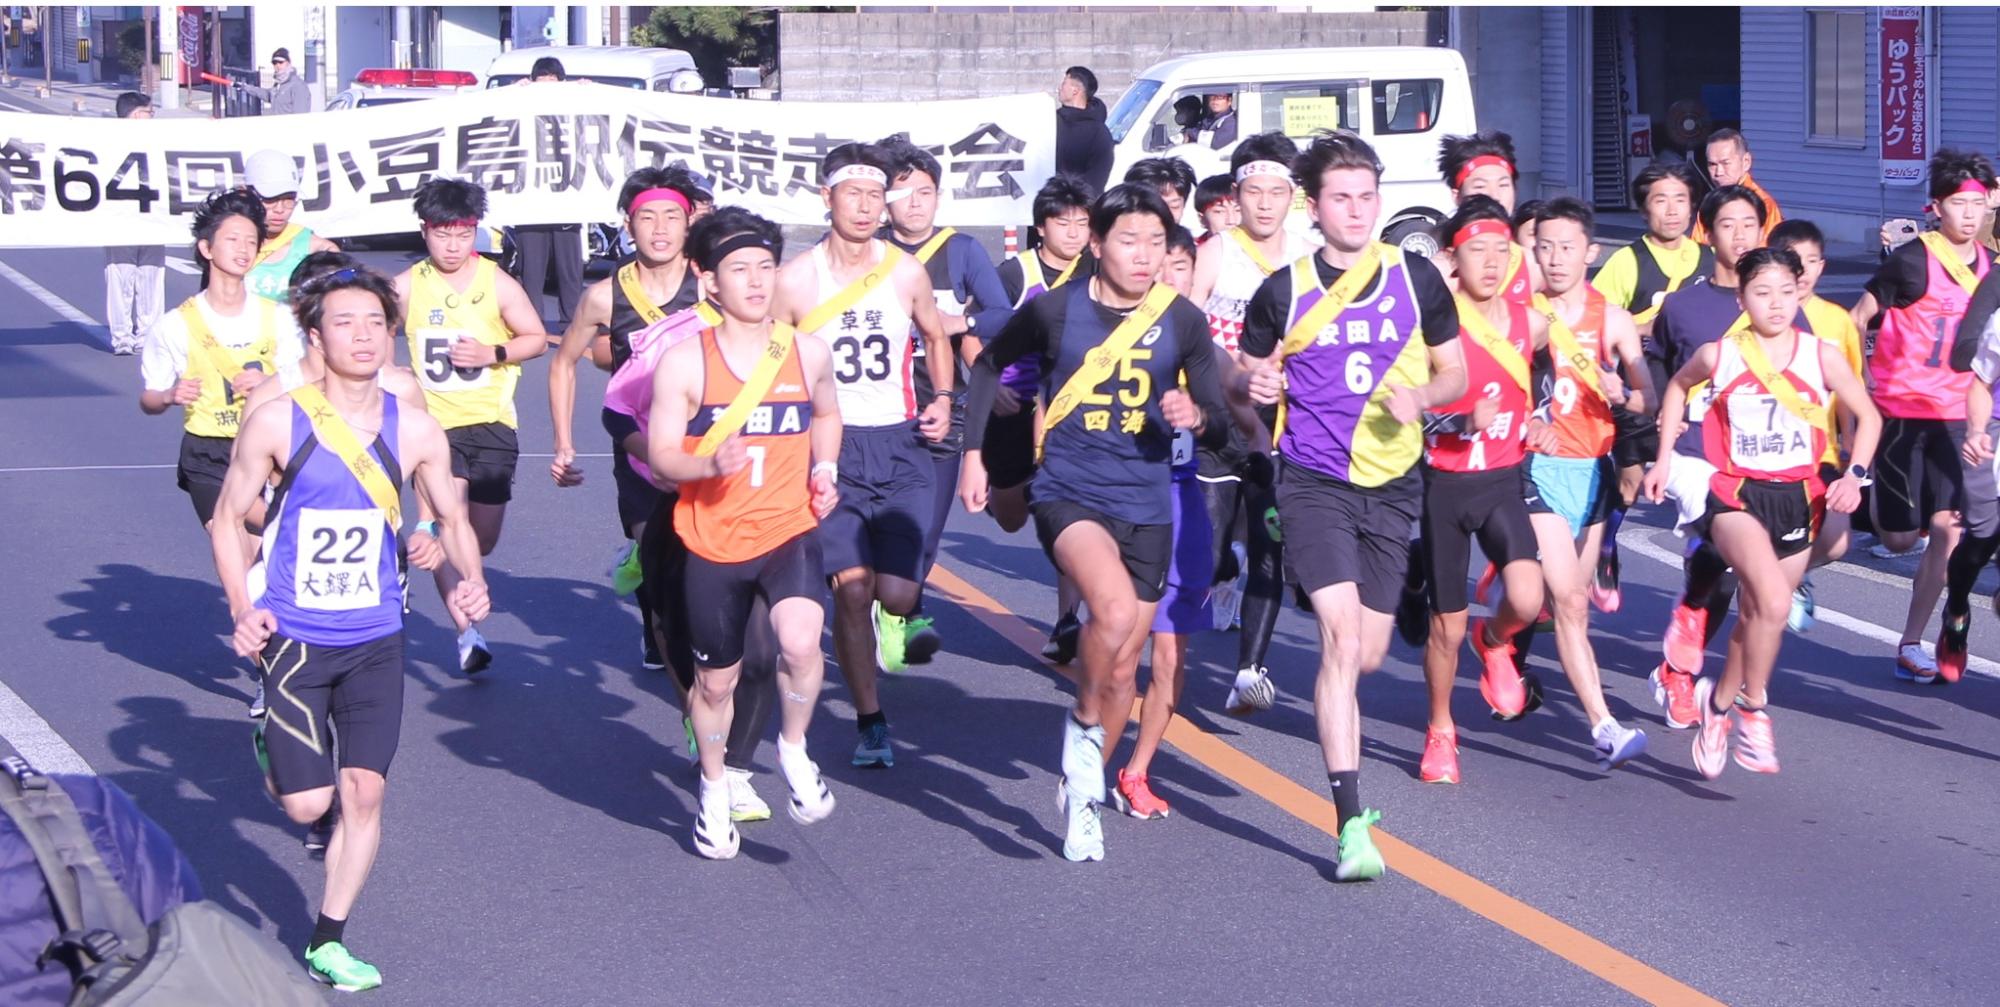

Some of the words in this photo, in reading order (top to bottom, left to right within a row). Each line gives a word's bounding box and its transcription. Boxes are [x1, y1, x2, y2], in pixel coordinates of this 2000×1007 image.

[1886, 38, 1910, 146] ゆうパック
[1885, 168, 1920, 177] ゆうパック
[428, 309, 445, 326] 西
[840, 309, 884, 331] 草壁
[1316, 318, 1400, 347] 安田A
[832, 334, 892, 384] 33
[1344, 351, 1374, 395] 6
[1081, 346, 1152, 408] 25
[1554, 377, 1577, 414] 9
[1083, 409, 1147, 434] 四海
[1760, 398, 1778, 431] 7
[746, 446, 765, 487] 1
[1467, 440, 1487, 470] A
[311, 526, 370, 564] 22
